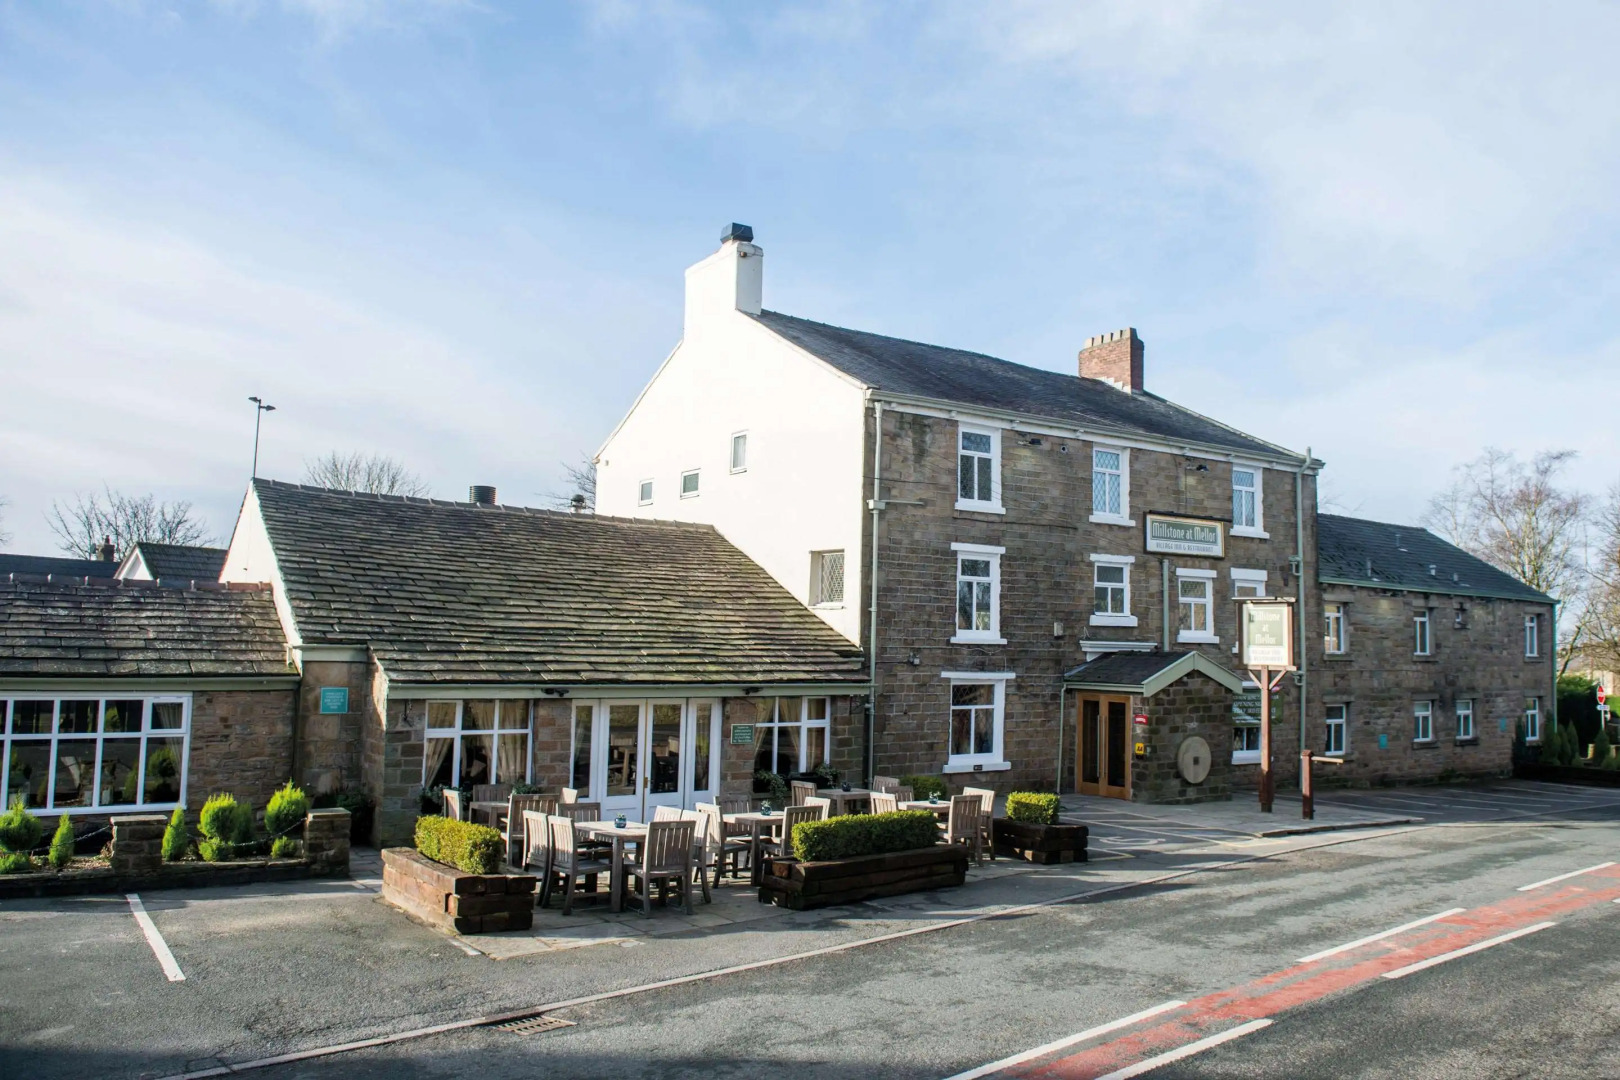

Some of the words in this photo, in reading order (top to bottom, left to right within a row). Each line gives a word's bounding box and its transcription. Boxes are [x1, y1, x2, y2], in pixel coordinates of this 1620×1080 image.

[1152, 522, 1185, 539] Millstone
[1185, 527, 1193, 540] at
[1194, 526, 1216, 542] Mellor
[1262, 623, 1269, 633] at
[1255, 633, 1276, 644] Mellor
